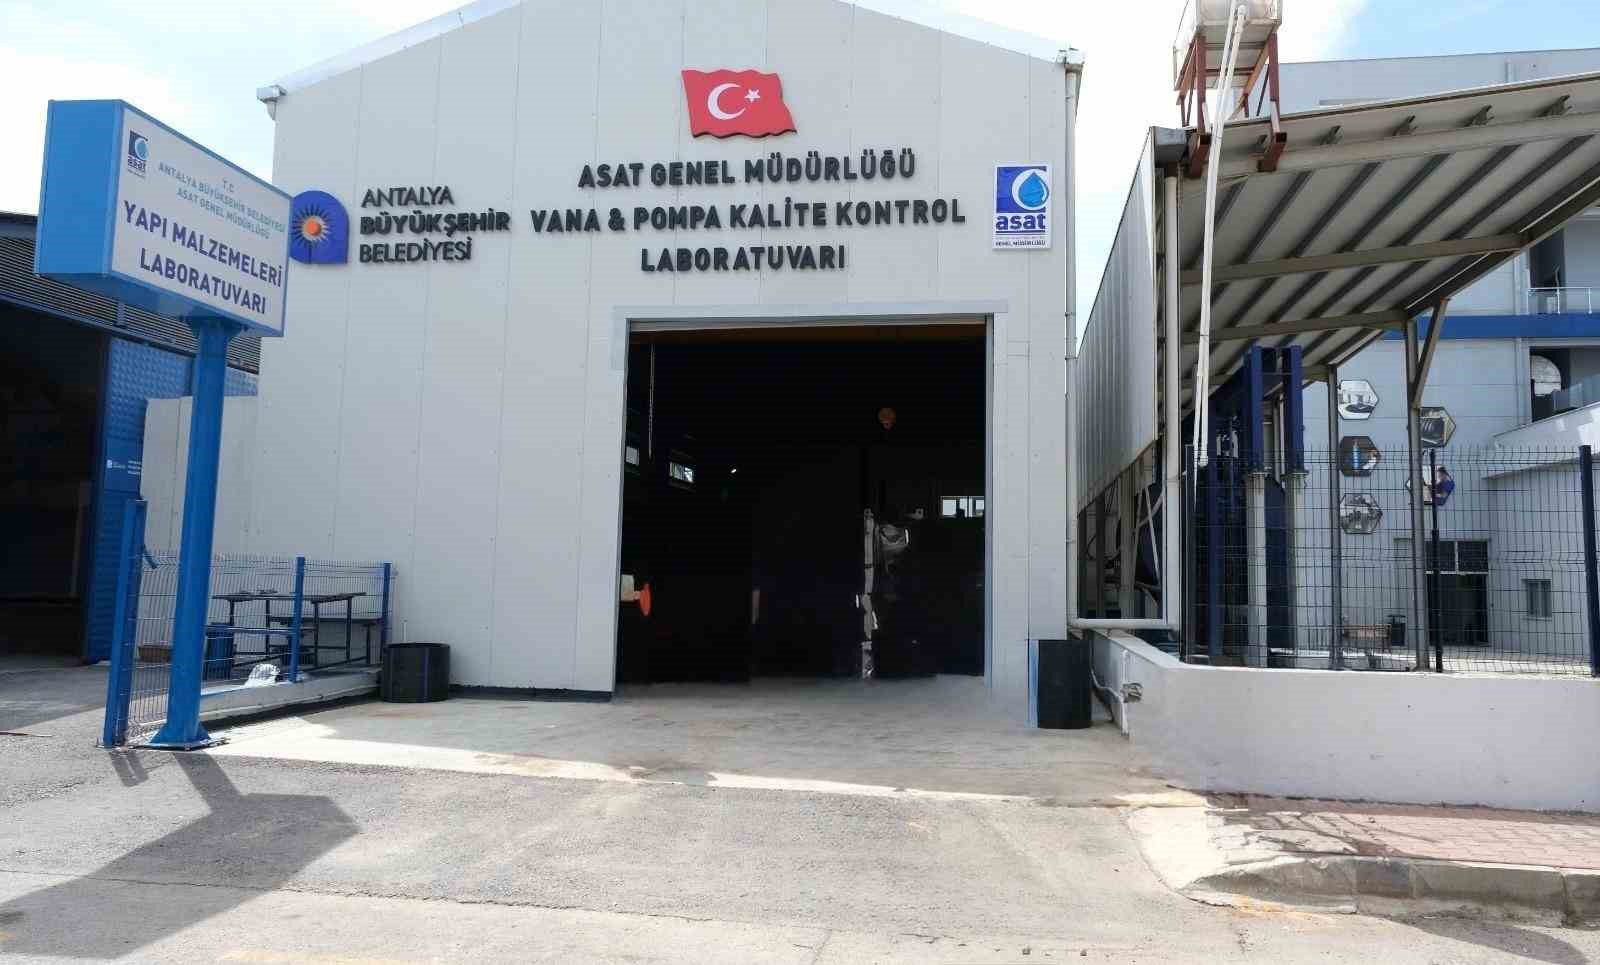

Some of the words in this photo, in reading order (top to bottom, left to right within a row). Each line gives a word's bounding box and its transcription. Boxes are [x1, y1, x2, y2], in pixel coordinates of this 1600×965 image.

[158, 162, 197, 188] ANTALYA
[578, 162, 645, 189] ASAT
[650, 159, 735, 187] GENEL
[744, 148, 916, 184] MÜDÜRLÜĞÜ
[176, 187, 199, 205] ASAT
[200, 198, 225, 218] GENEL
[362, 186, 454, 208] ANTALYA
[360, 208, 512, 237] BÜYÜKŞEHİR
[531, 208, 601, 233] VANA
[608, 208, 626, 232] &
[633, 204, 722, 231] POMPA
[729, 196, 827, 229] KALİTE
[836, 198, 966, 227] KONTROL
[995, 213, 1046, 230] asat
[124, 200, 168, 238] YAPI
[172, 222, 283, 288] MALZEMELERİ
[359, 236, 472, 263] BELEDİYESİ
[640, 245, 846, 273] LABORATUVARI
[140, 247, 266, 314] LABORATUVARI
